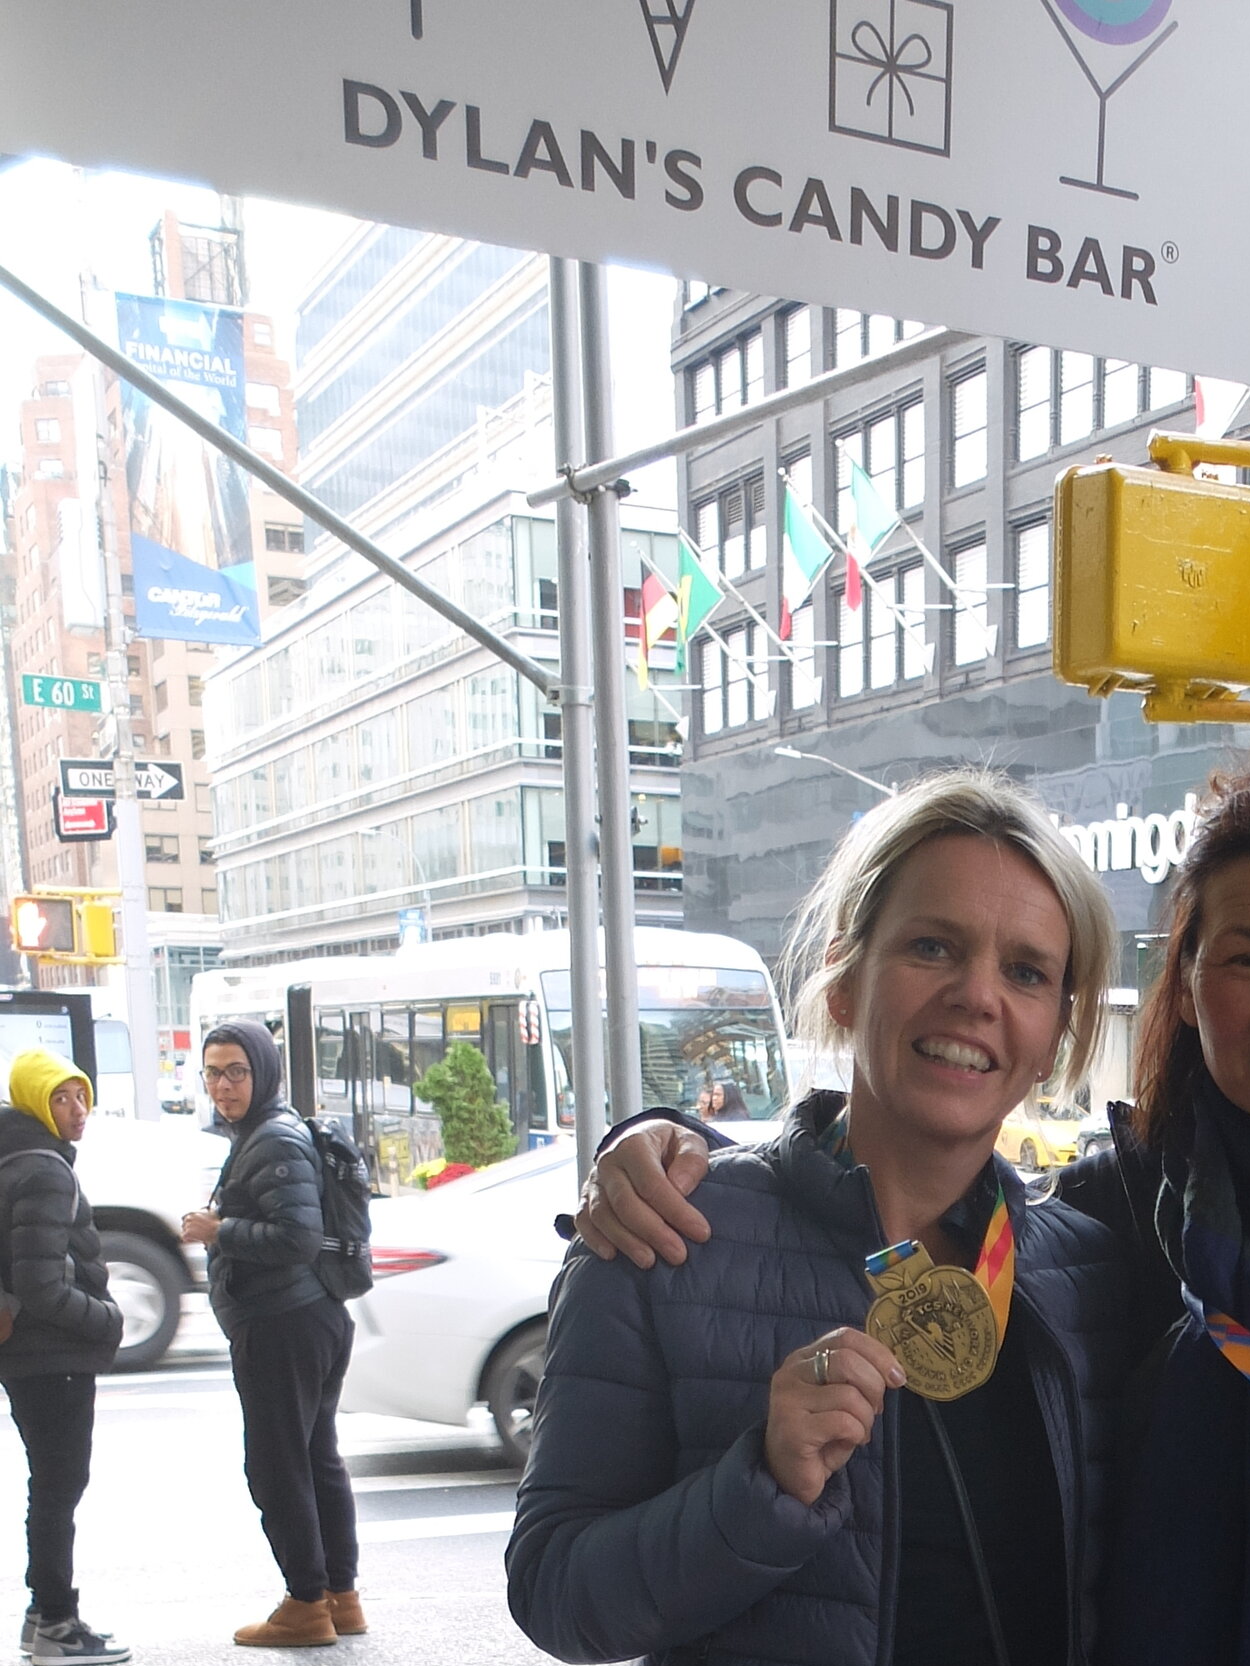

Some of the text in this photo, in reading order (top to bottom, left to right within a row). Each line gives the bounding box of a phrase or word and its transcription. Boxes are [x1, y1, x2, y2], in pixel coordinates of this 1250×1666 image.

[343, 78, 705, 211] DYLAN'S
[733, 166, 1002, 270] CANDY
[125, 341, 237, 375] FINANCIAL
[204, 372, 237, 387] World
[32, 678, 95, 706] E 60 St
[79, 771, 113, 788] ONE
[899, 1283, 928, 1303] 2019
[916, 1302, 942, 1316] TCS
